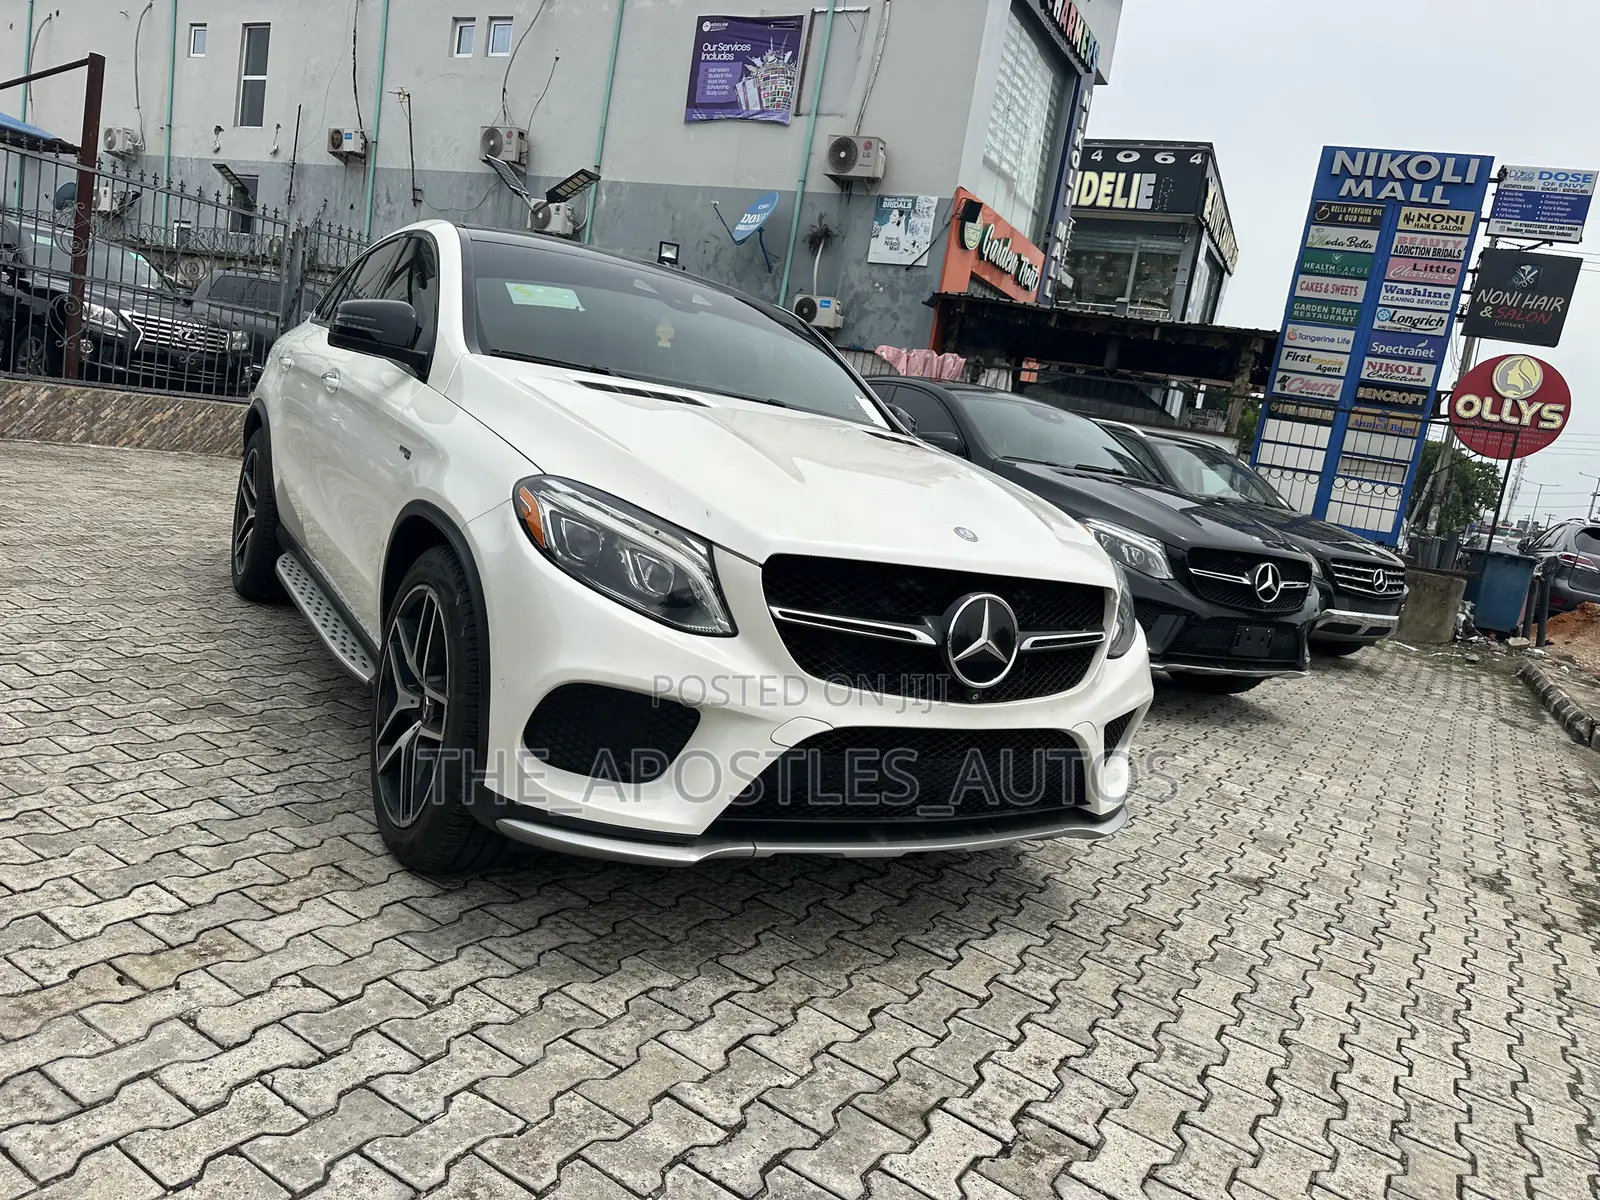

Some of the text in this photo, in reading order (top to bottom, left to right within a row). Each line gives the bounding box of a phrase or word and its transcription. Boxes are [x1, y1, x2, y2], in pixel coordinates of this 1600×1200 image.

[1047, 0, 1100, 73] HARMERS
[702, 42, 751, 51] Our Services
[701, 52, 734, 60] Includes
[1330, 150, 1480, 184] NIKOLI
[1538, 171, 1593, 184] DOSE
[1338, 178, 1450, 205] MALL
[882, 201, 912, 209] BRIDALS
[1347, 207, 1372, 215] PERFUME
[1372, 208, 1382, 216] OIL
[1344, 214, 1358, 222] OUD
[1416, 212, 1466, 226] NONI
[1414, 222, 1431, 230] HAIR
[1440, 224, 1463, 232] SALON
[1346, 236, 1374, 248] Bella
[1397, 236, 1463, 249] BEAUTY
[1394, 244, 1462, 259] ADDICTION BRIDALS
[1304, 262, 1368, 274] HEALTHGARDE
[1412, 262, 1456, 274] Little
[1300, 280, 1358, 296] CAKES & SWEETS
[1384, 284, 1452, 300] Washline
[1476, 288, 1564, 312] NONI HAIR
[1294, 302, 1358, 317] GARDEN TREAT
[1294, 310, 1356, 322] RESTAURANT
[1480, 306, 1552, 324] & SALON
[1388, 310, 1445, 328] Longrich
[1494, 320, 1524, 330] (unisex)
[1298, 332, 1350, 345] Tangerine Life
[1370, 342, 1435, 358] Spectranet
[1316, 364, 1342, 373] Agent
[1366, 360, 1423, 376] NIKOLI
[1366, 370, 1426, 382] Collections
[1288, 377, 1340, 395] Cherry
[1356, 386, 1426, 406] BENCROFT
[1455, 394, 1566, 430] OLLYS
